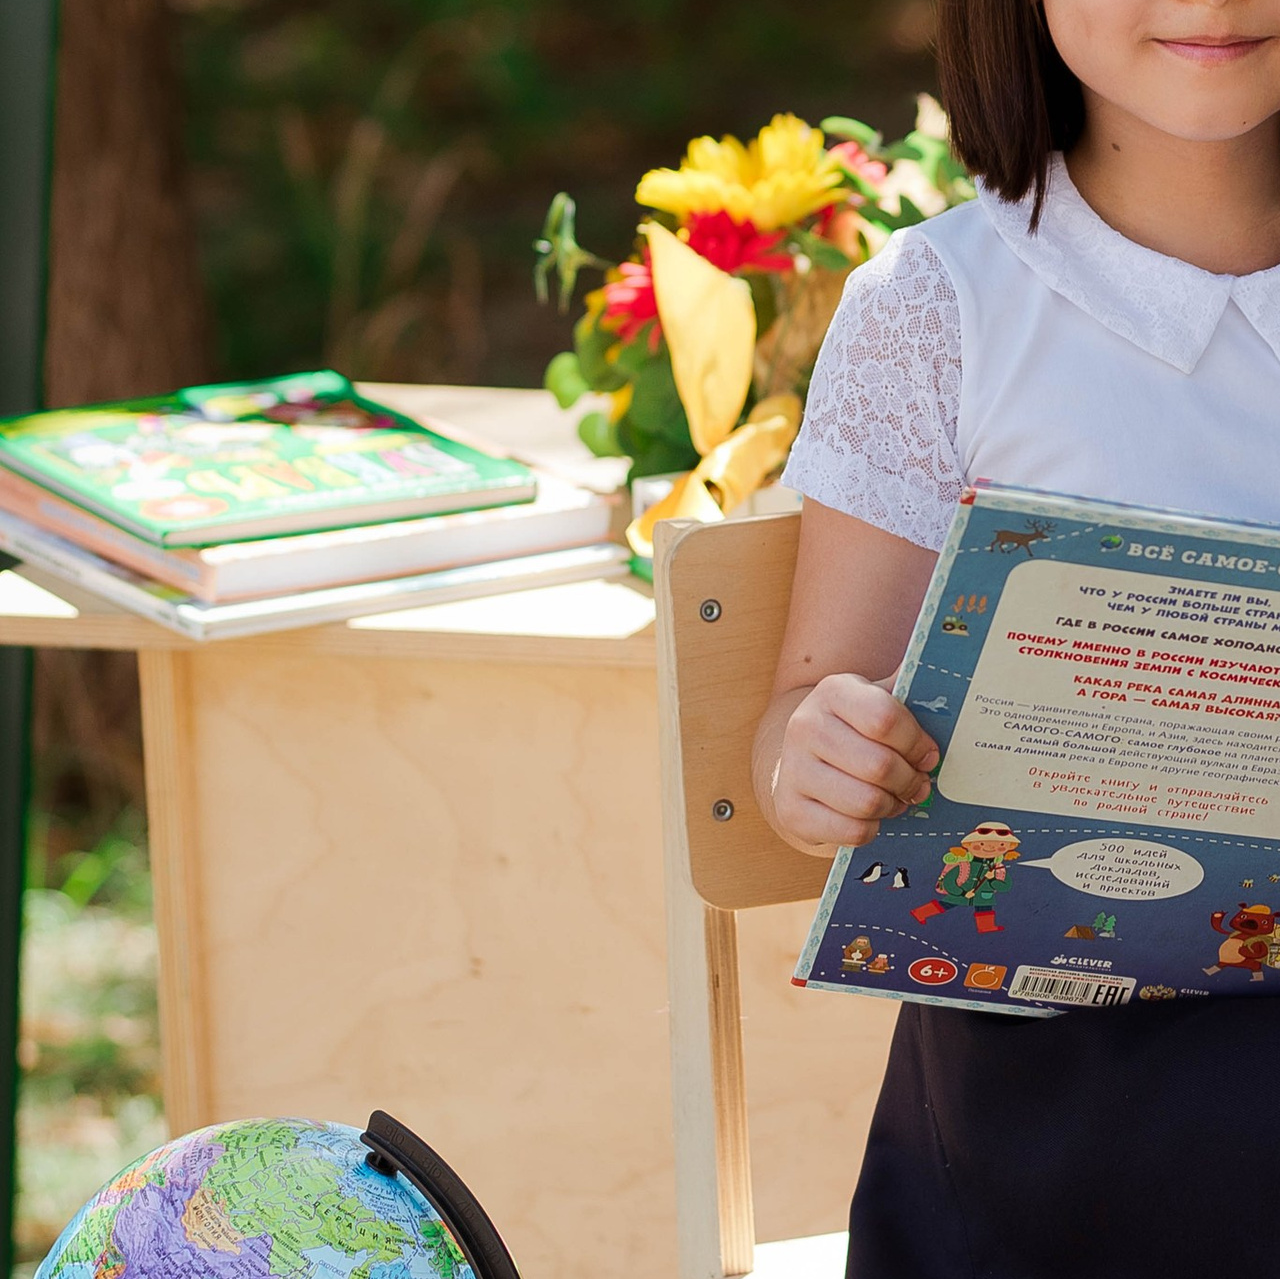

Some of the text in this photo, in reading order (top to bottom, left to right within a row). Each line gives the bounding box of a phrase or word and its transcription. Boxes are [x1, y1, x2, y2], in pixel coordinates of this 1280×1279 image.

[1126, 542, 1175, 561] ВСЁ
[1079, 585, 1107, 597] ЧТО
[1111, 590, 1123, 599] У
[1126, 592, 1178, 607] РОССИИ
[1182, 599, 1241, 615] БОЛЬШЕ
[1168, 585, 1218, 600] ЗНАЕТЕ
[1221, 593, 1242, 603] ЛИ
[1107, 601, 1135, 613] ЧЕМ
[1140, 606, 1152, 615] У
[1155, 608, 1209, 623] ЛЮБОЙ
[1213, 616, 1268, 631] СТРАНЫ
[1055, 616, 1083, 628] ГДЕ
[1087, 620, 1097, 630] В
[1102, 622, 1156, 638] РОССИИ
[1160, 631, 1210, 645] САМОЕ
[1006, 631, 1068, 647] ПОЧЕМУ
[1071, 640, 1132, 656] ИМЕННО
[1136, 649, 1146, 658] В
[1151, 651, 1205, 666] РОССИИ
[1018, 646, 1129, 668] СТОЛКНОВЕНИЯ
[1133, 661, 1183, 675] ЗЕМЛИ
[1186, 668, 1195, 677] С
[1073, 675, 1123, 689] КАКАЯ
[1126, 682, 1162, 694] РЕКА
[1168, 687, 1218, 701] САМАЯ
[1076, 688, 1087, 697] А
[1091, 690, 1127, 702] ГОРА
[1151, 698, 1201, 712] САМАЯ
[974, 694, 1015, 707] Россия
[1031, 704, 1112, 720] удивительная
[1159, 721, 1235, 736] поражающая
[1237, 730, 1273, 741] своим
[979, 706, 1001, 716] Это
[1003, 711, 1089, 729] одновременно
[1192, 736, 1224, 746] здесь
[974, 741, 1012, 752] самая
[1013, 746, 1067, 759] длинная
[1068, 753, 1096, 763] река
[1107, 757, 1149, 770] Европе
[1159, 766, 1200, 776] другие
[1019, 736, 1060, 747] самый
[1062, 740, 1117, 755] большой
[1118, 749, 1198, 765] действующий
[1199, 759, 1239, 770] вулкан
[1127, 739, 1165, 750] самое
[1166, 744, 1222, 757] глубокое
[1224, 751, 1238, 759] на
[1028, 766, 1269, 805] Откройте книгу и отправляйтесь
[1032, 781, 1256, 816] в увлекательное путешествие
[1073, 798, 1209, 821] по родной стране!
[1076, 852, 1181, 871] для школьных
[1099, 842, 1168, 859] 500 идей
[1075, 871, 1170, 889] исследований
[1082, 882, 1156, 897] и проектов
[919, 964, 949, 978] 6+
[1068, 957, 1113, 968] CLEVER
[318, 1259, 347, 1279] ОХОТСКОЕ
